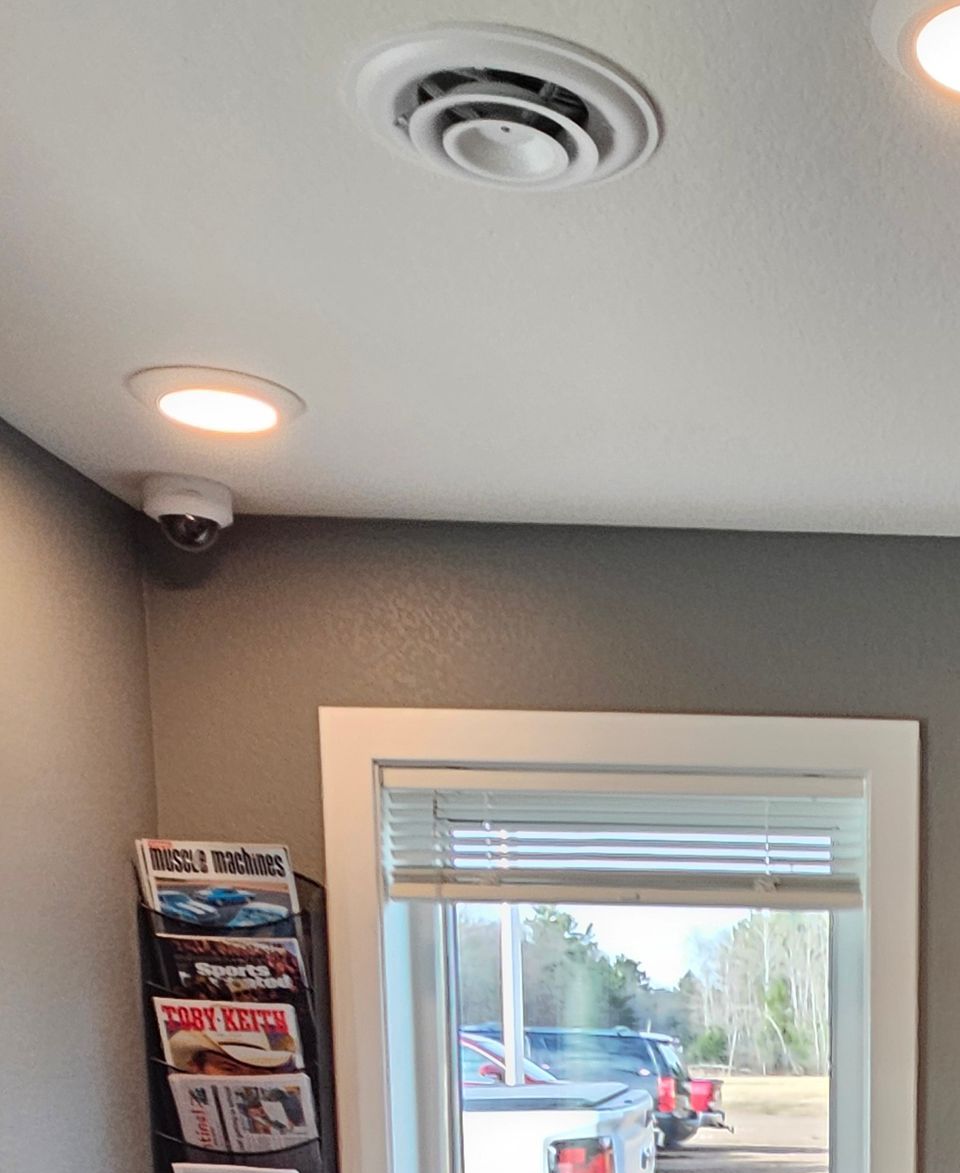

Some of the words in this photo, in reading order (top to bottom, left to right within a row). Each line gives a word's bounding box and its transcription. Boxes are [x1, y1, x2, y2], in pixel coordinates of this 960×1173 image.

[211, 847, 286, 877] machines
[195, 962, 271, 979] Sports
[161, 1005, 217, 1031] TOBY
[220, 1008, 288, 1033] KEITH
